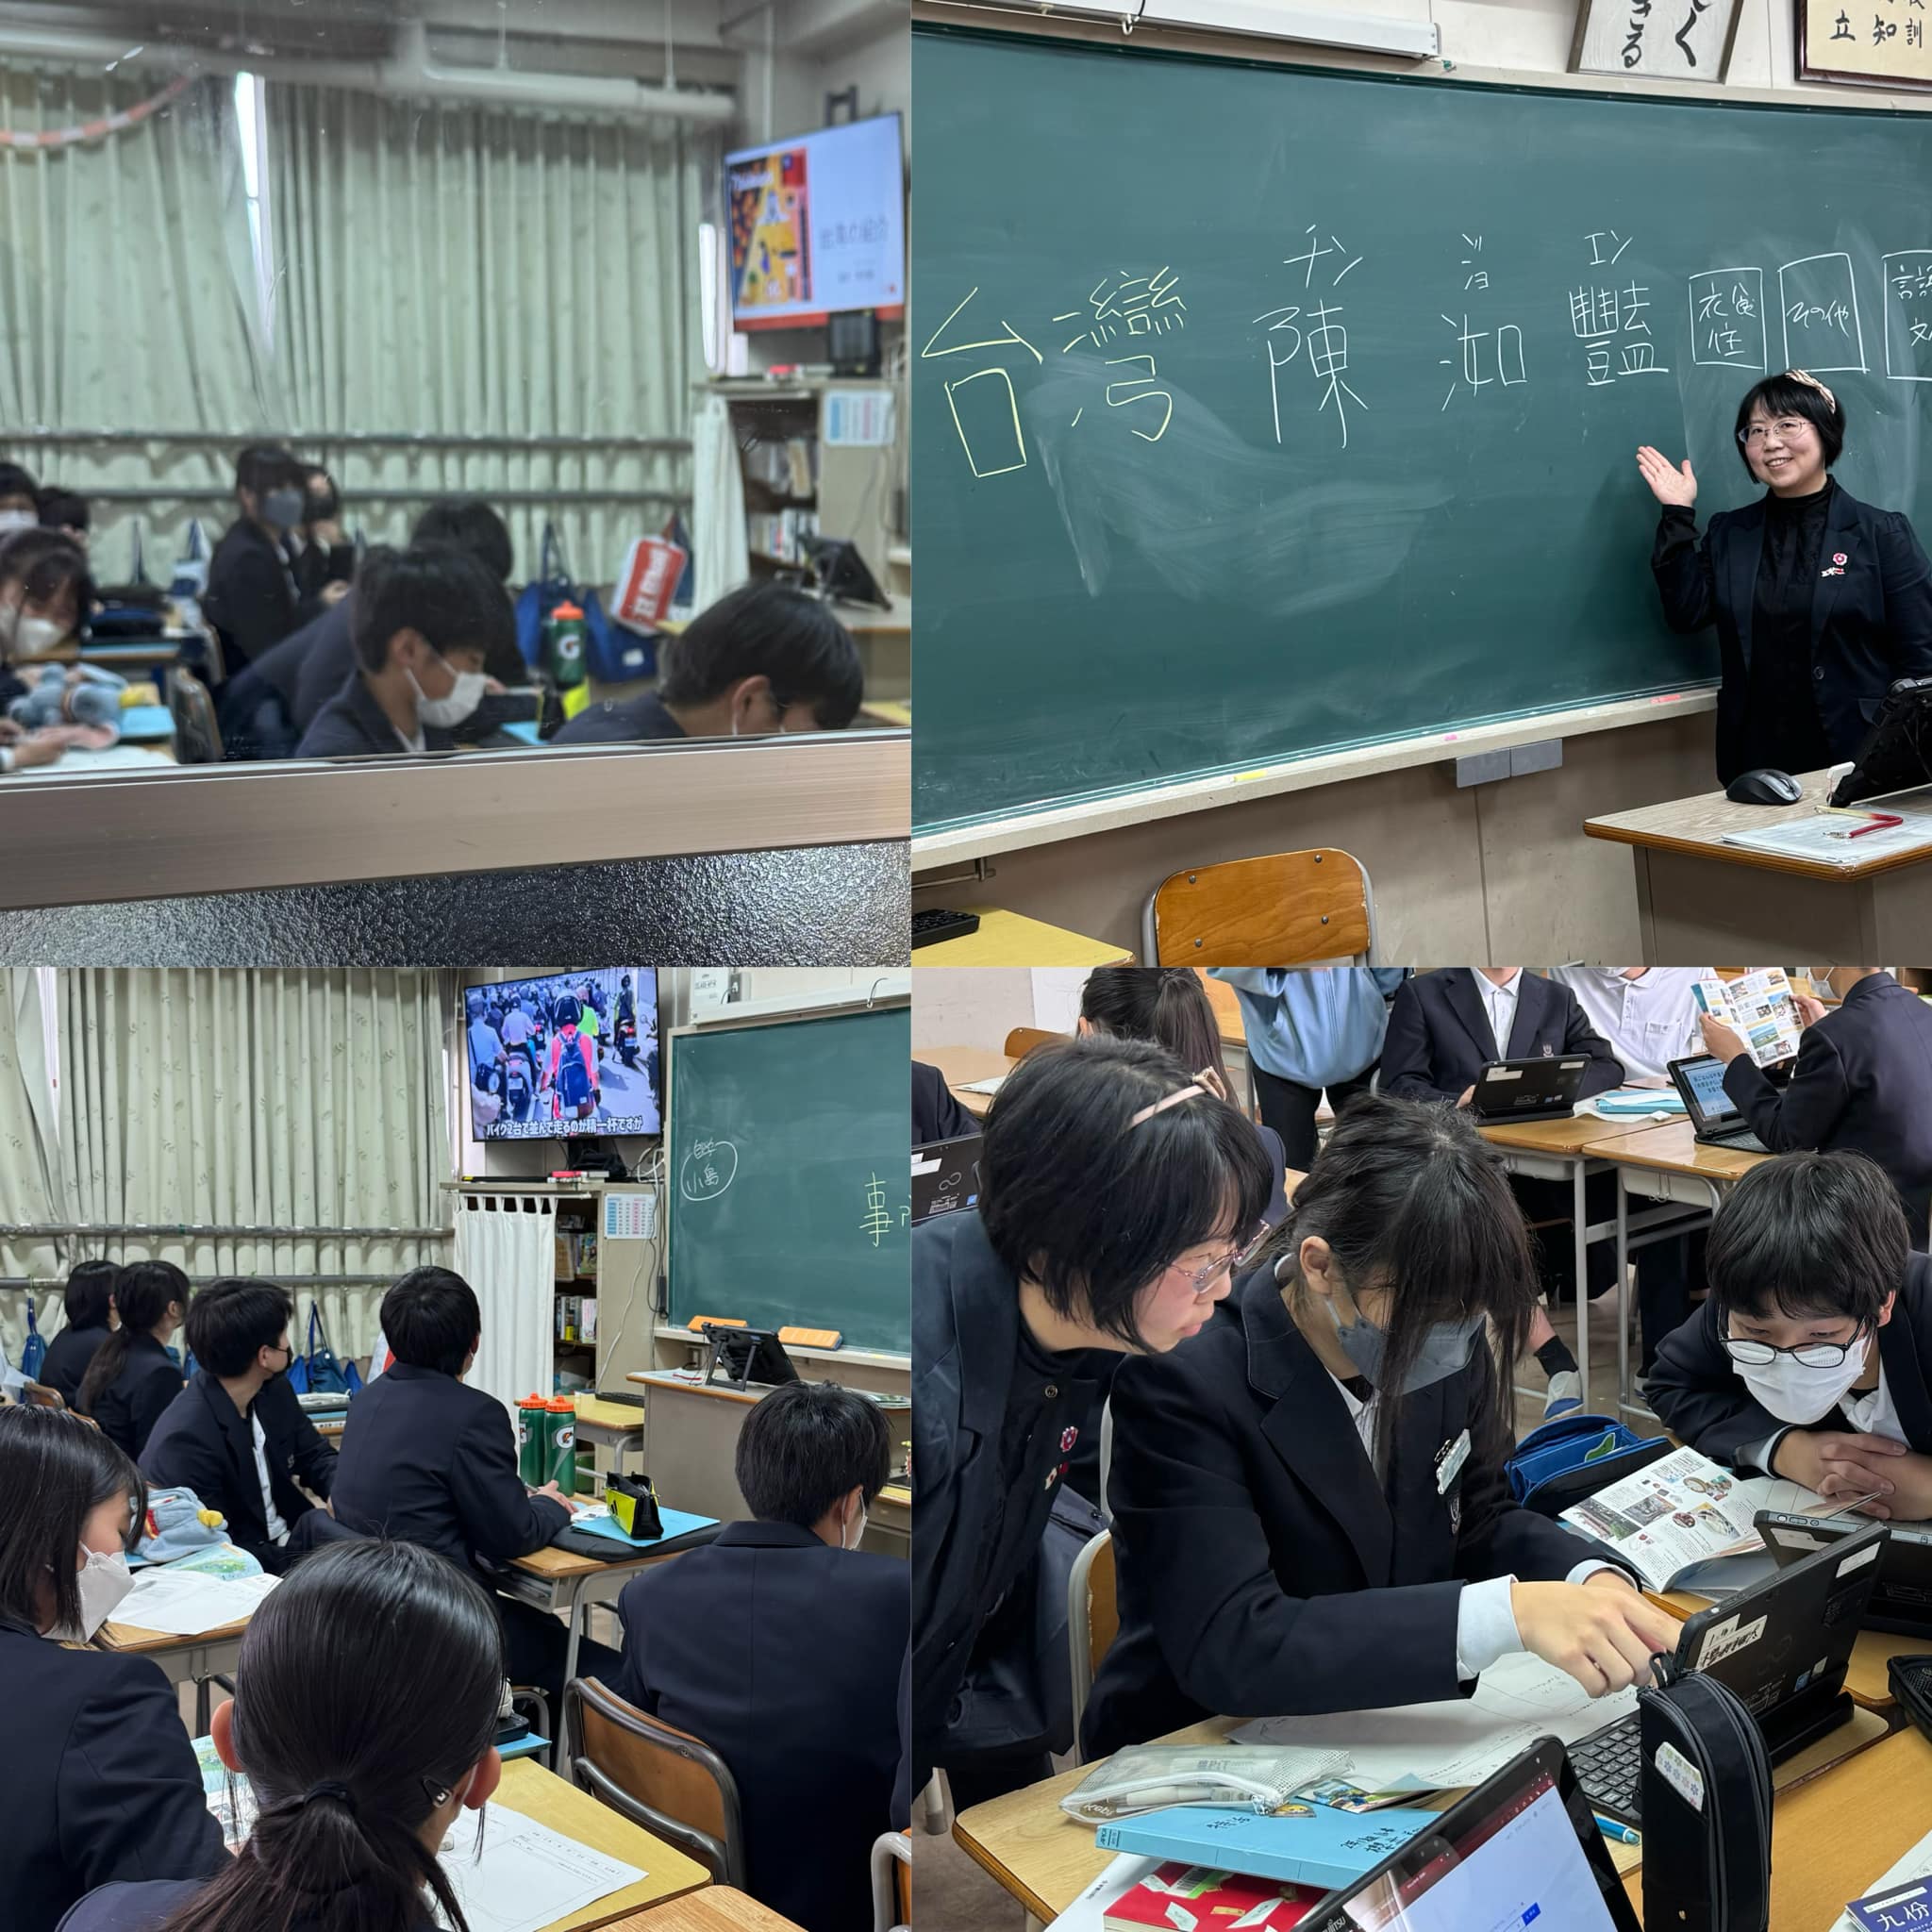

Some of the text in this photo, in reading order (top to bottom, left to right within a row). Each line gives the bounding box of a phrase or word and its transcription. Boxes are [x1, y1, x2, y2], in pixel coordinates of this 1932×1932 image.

[1909, 317, 1932, 347] 文
[557, 1425, 575, 1449] G
[1876, 1901, 1929, 1932] 九份
